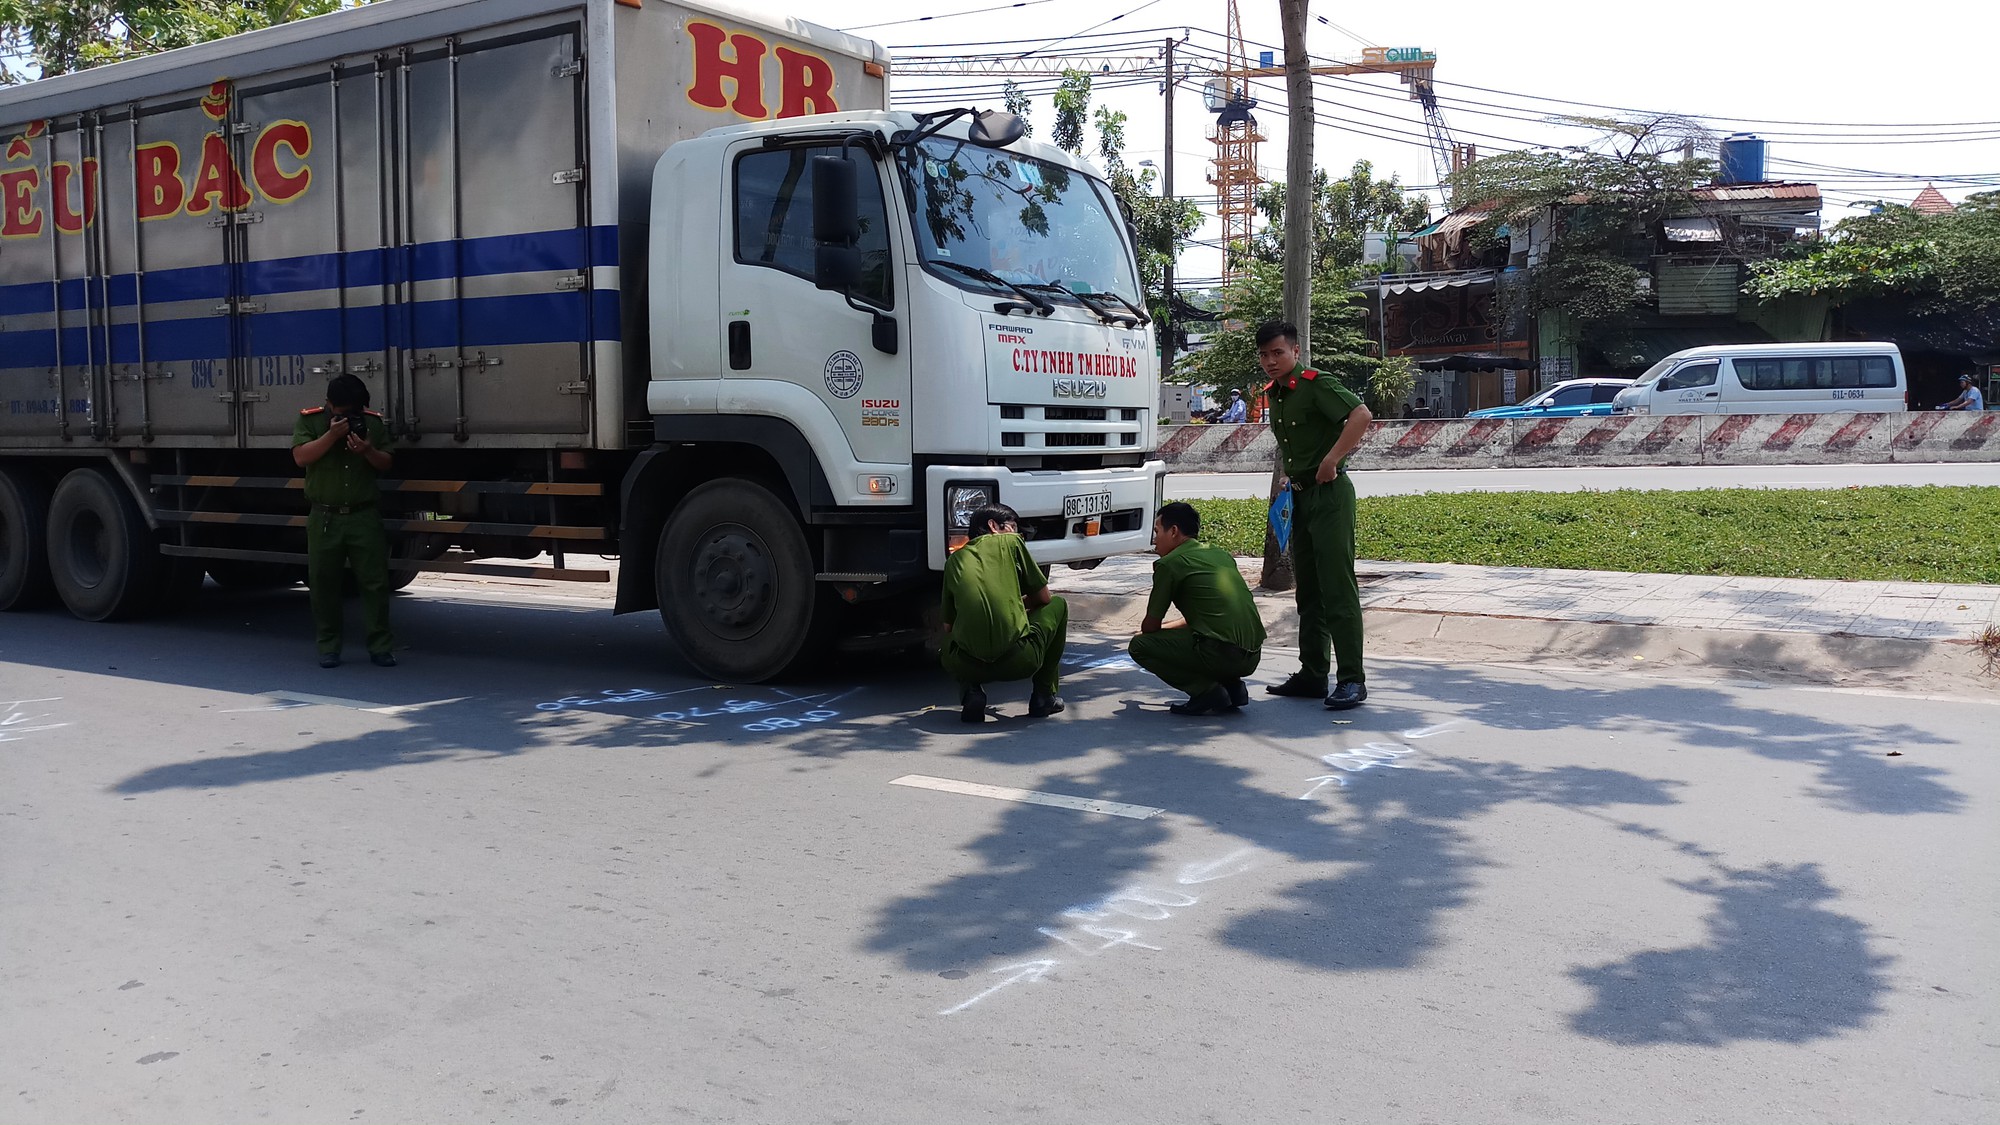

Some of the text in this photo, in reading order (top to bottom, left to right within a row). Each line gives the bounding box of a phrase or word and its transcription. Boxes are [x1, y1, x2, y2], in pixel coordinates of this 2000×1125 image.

[130, 78, 313, 223] BẮC
[988, 323, 1034, 335] FORWARD
[998, 333, 1027, 345] MAX
[1013, 348, 1039, 372] C.TY
[1041, 350, 1074, 375] TNHH
[1078, 353, 1093, 376] TM
[1052, 378, 1107, 399] ISUZU
[861, 399, 900, 409] ISUZU
